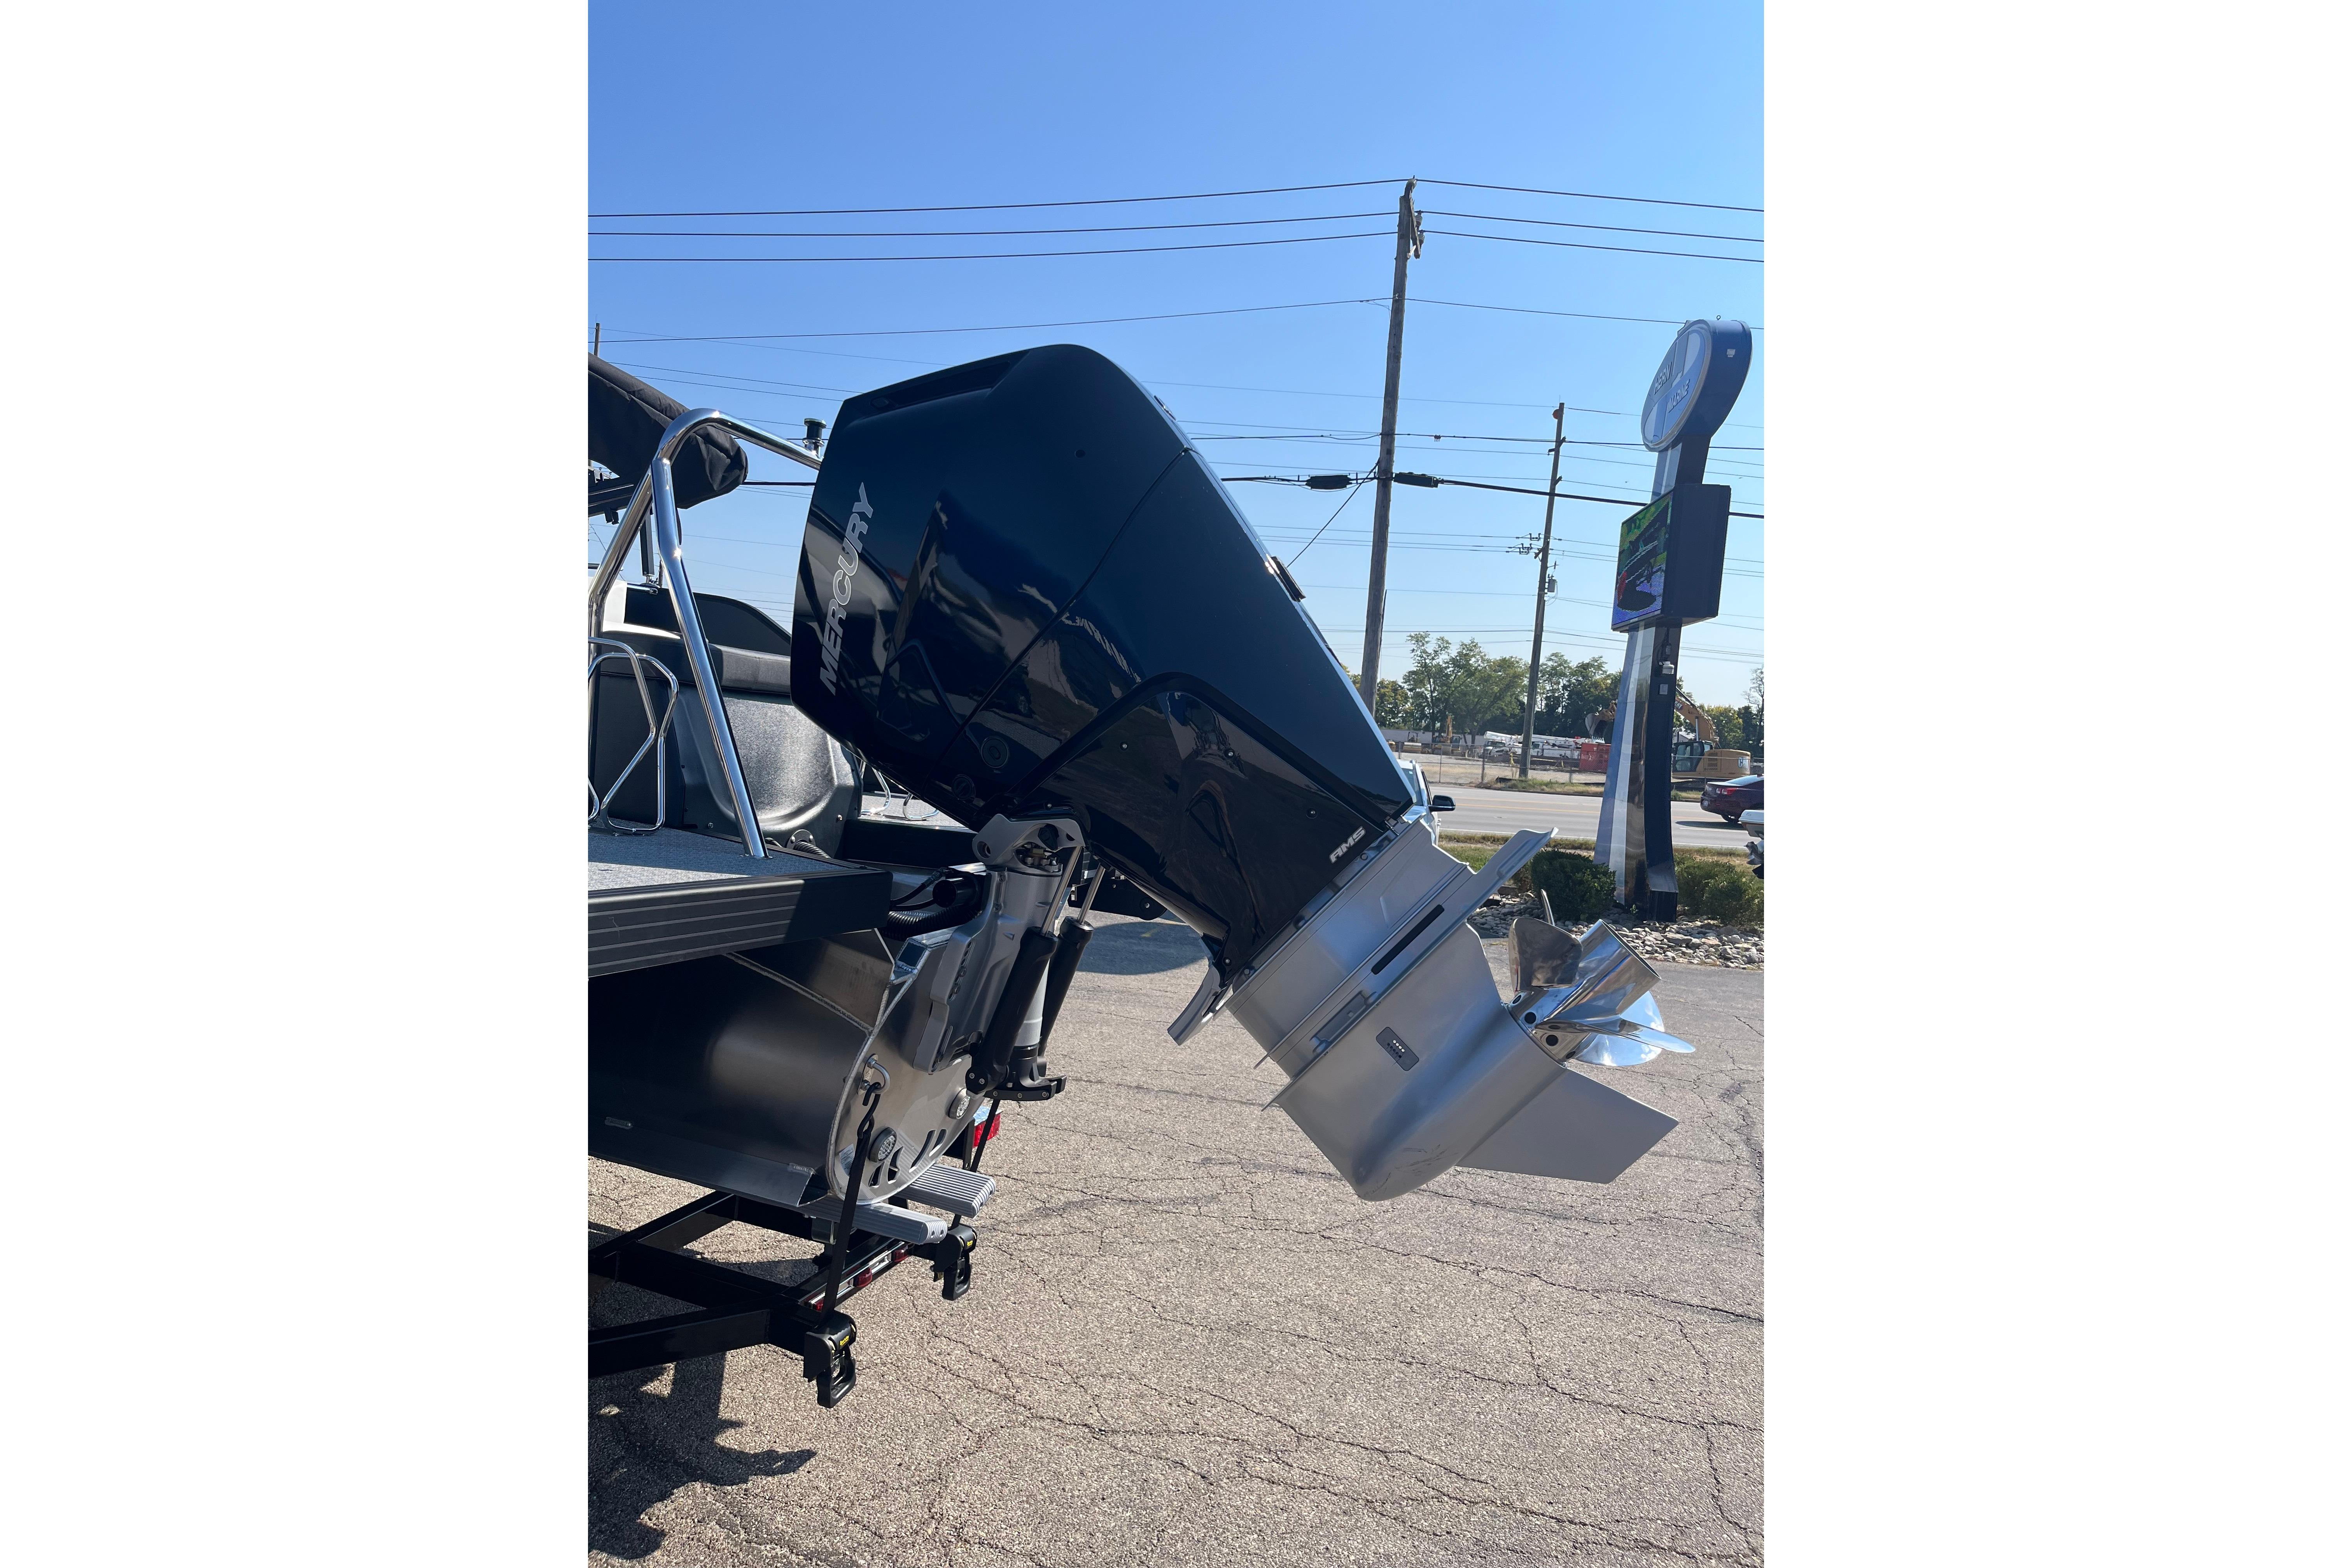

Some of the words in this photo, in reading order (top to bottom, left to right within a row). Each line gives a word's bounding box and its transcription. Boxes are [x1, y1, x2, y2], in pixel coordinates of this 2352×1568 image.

[1654, 362, 1672, 395] HERN
[1668, 379, 1690, 413] MARINE
[819, 481, 873, 696] MERCURY
[1329, 826, 1366, 864] AMS
